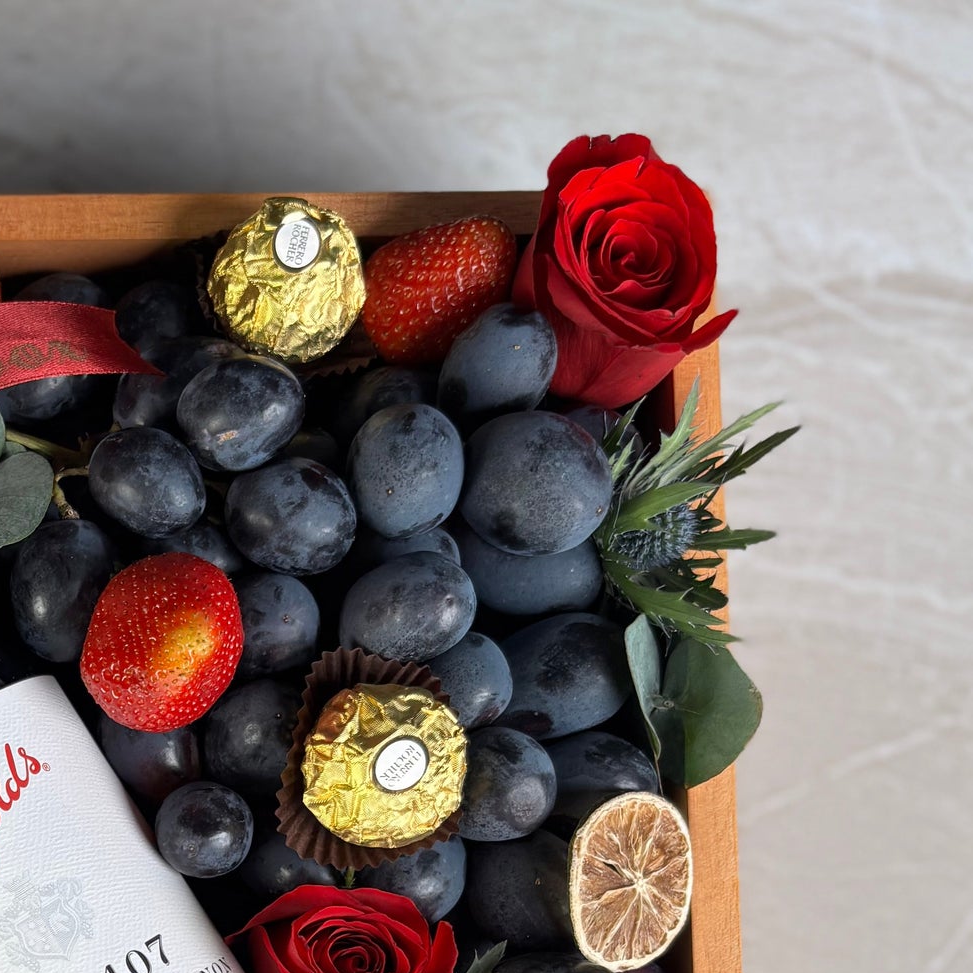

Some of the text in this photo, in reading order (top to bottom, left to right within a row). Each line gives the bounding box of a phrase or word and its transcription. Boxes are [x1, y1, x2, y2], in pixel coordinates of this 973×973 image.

[286, 224, 301, 262] ROCHER
[294, 226, 311, 265] FERRERO
[380, 745, 415, 781] ROCHER
[388, 751, 421, 787] FERRERO
